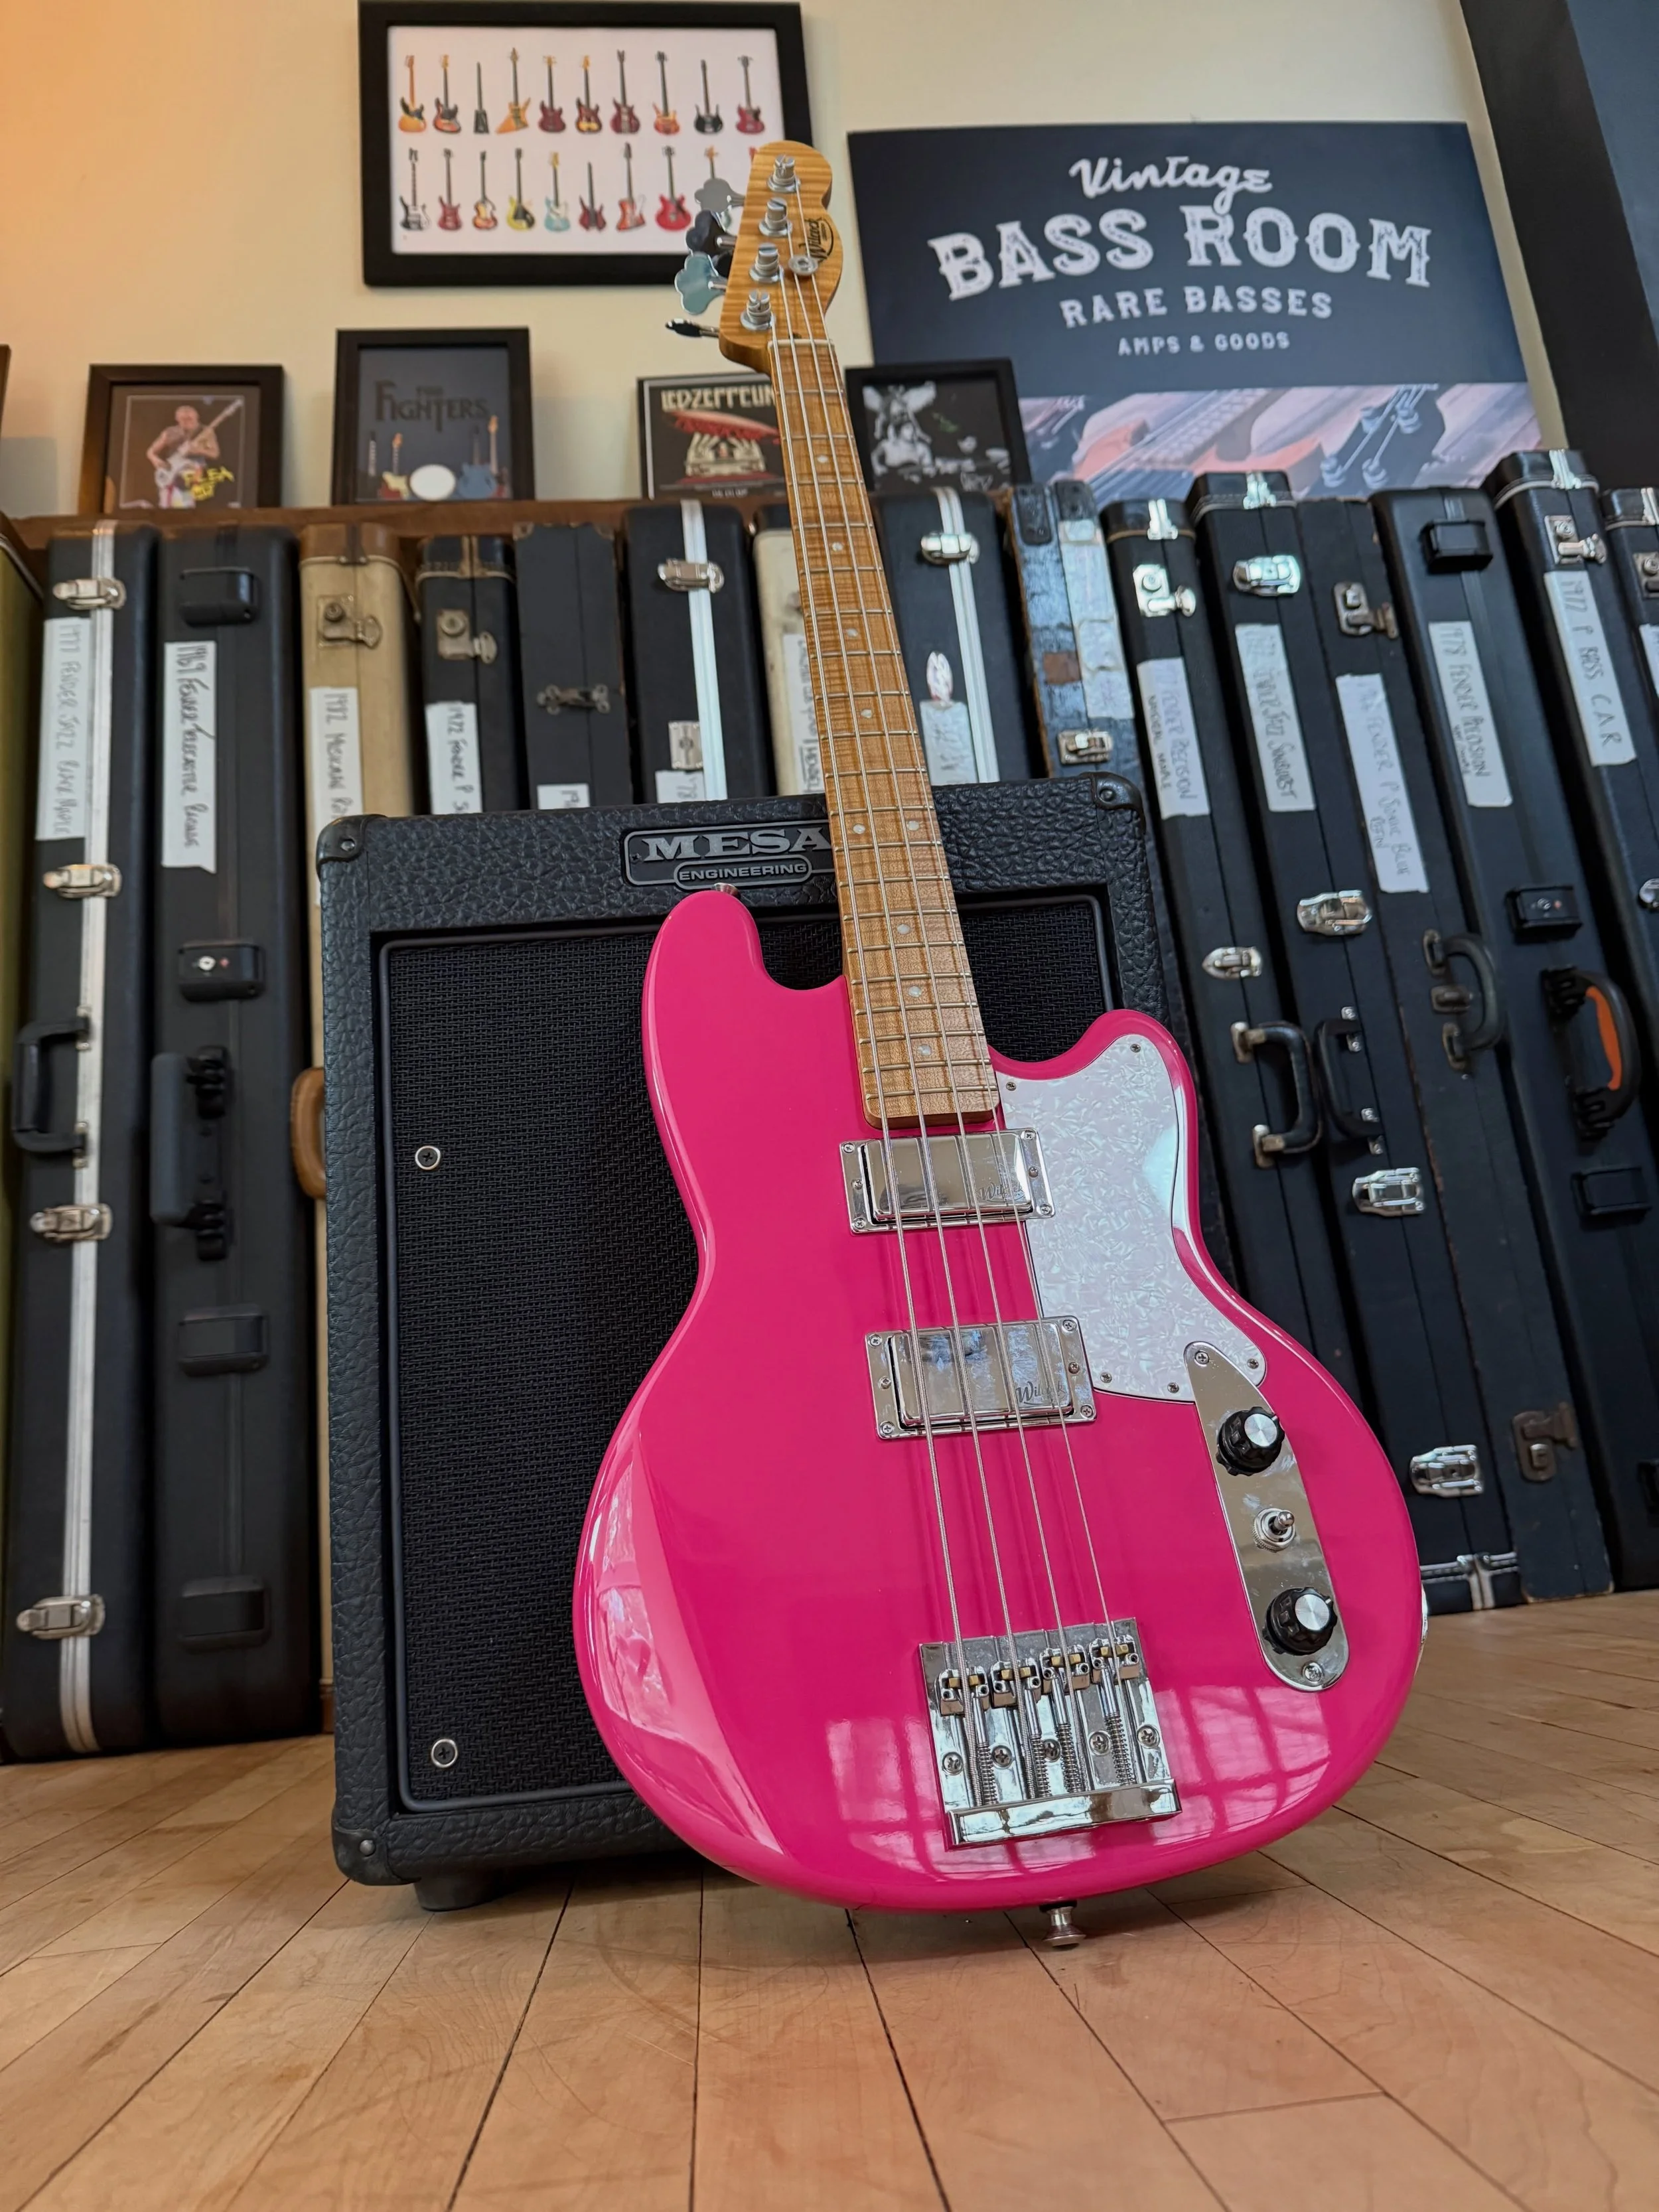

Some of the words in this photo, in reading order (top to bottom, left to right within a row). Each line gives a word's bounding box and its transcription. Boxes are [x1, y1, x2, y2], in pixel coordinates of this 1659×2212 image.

[1069, 156, 1273, 215] Vintage
[928, 208, 1153, 301] BASS
[1179, 204, 1432, 288] ROOM
[1059, 287, 1168, 329] RARE
[1183, 285, 1333, 319] BASSES
[1118, 335, 1180, 356] AMPS
[1190, 334, 1204, 353] &
[1214, 331, 1291, 351] GOODS
[56, 660, 82, 708] FENDER
[56, 713, 81, 749] JAZZ
[641, 827, 830, 861] MESA
[678, 863, 808, 881] ENGINEERING
